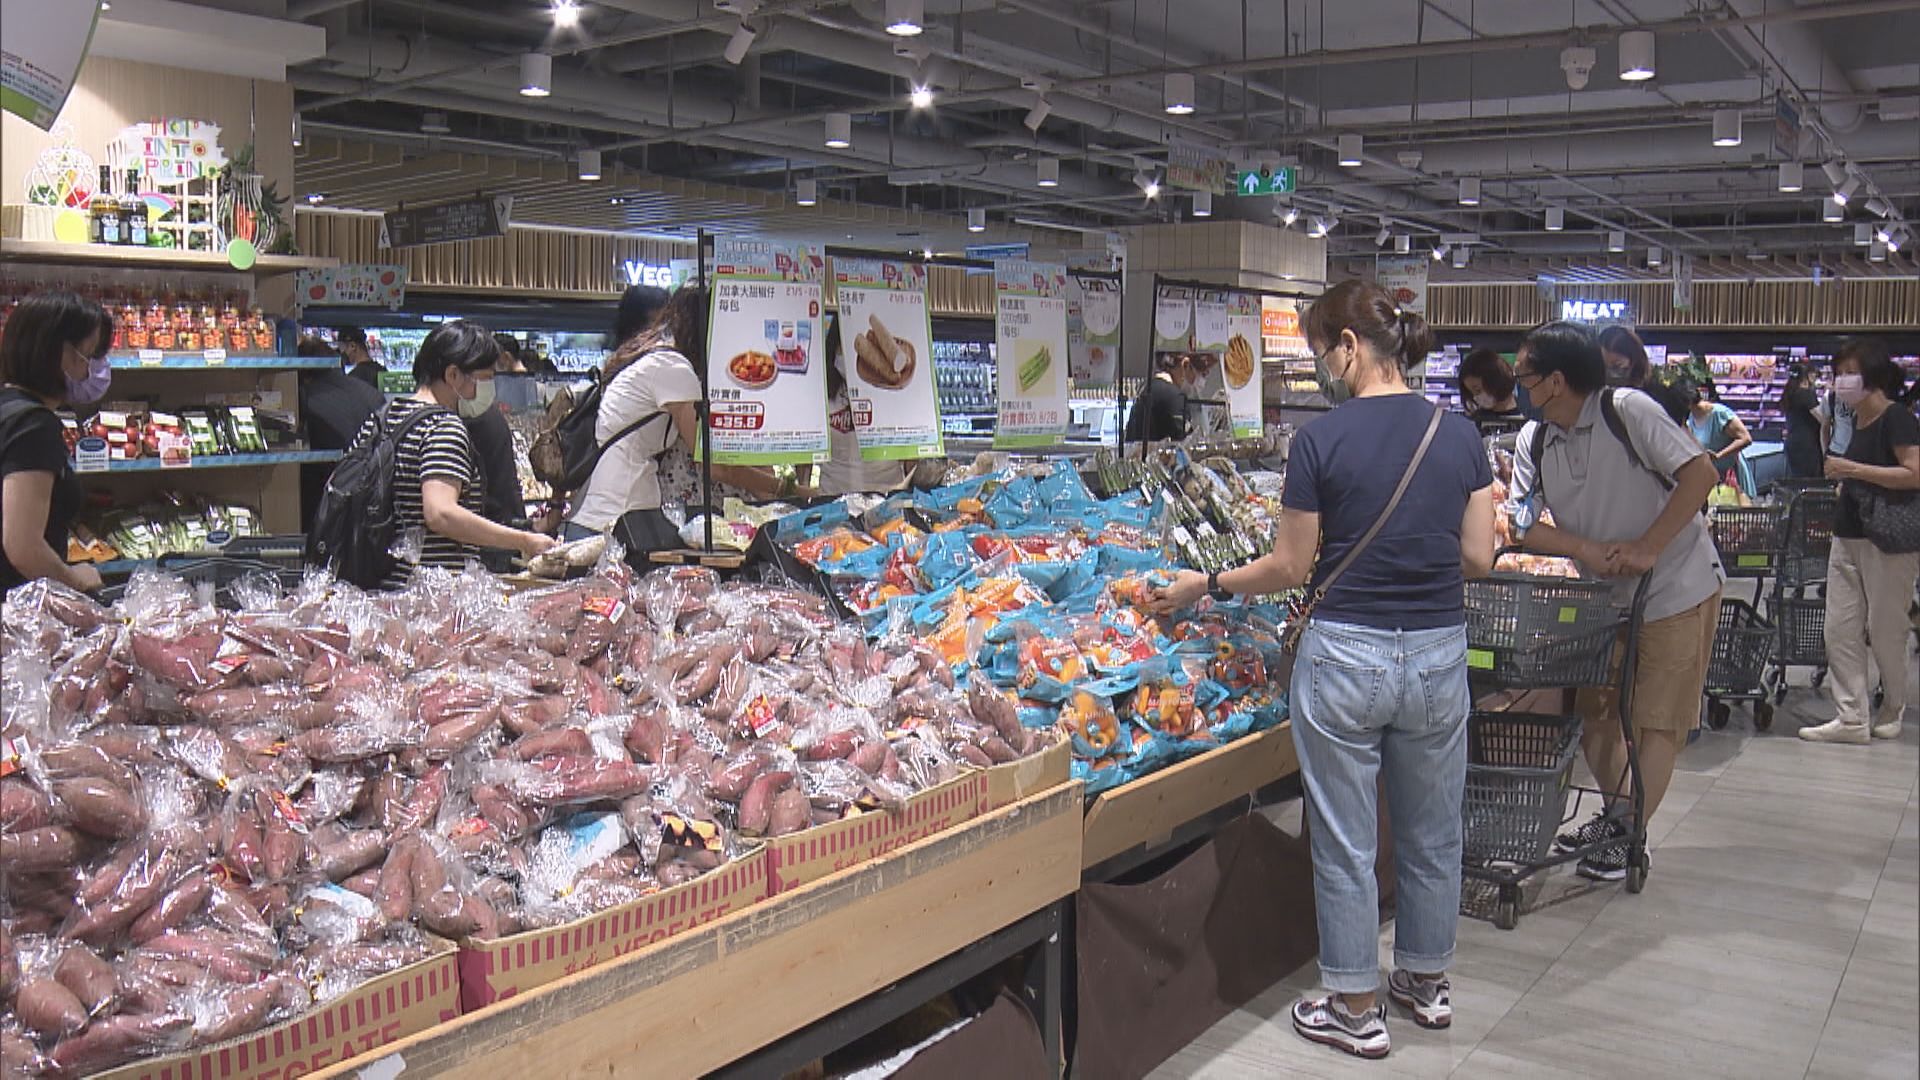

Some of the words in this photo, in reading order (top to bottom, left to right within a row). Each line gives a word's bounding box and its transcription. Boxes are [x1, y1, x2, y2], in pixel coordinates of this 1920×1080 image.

[143, 137, 207, 158] INTO
[1562, 301, 1626, 321] MEAT
[714, 415, 757, 428] $35.8
